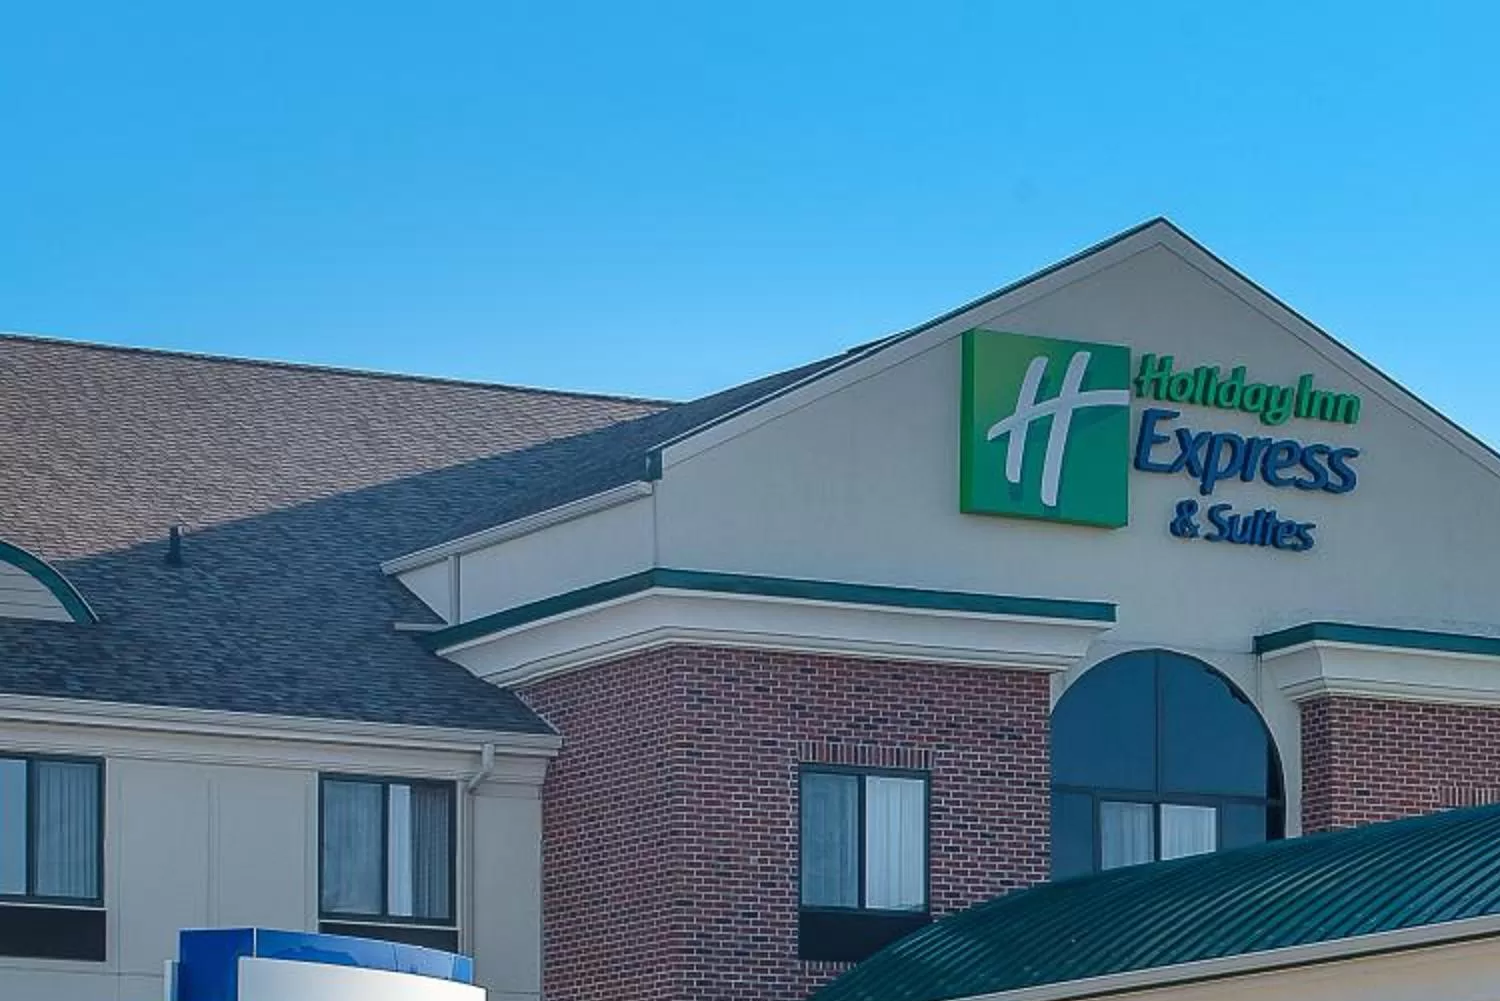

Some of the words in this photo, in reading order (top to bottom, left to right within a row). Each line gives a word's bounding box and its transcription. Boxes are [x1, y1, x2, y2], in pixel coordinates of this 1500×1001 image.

[987, 351, 1130, 506] H
[1134, 353, 1294, 425] Holiday
[1294, 374, 1361, 424] Inn
[1134, 408, 1360, 494] Express
[1169, 500, 1199, 538] &
[1204, 503, 1316, 551] Suites
